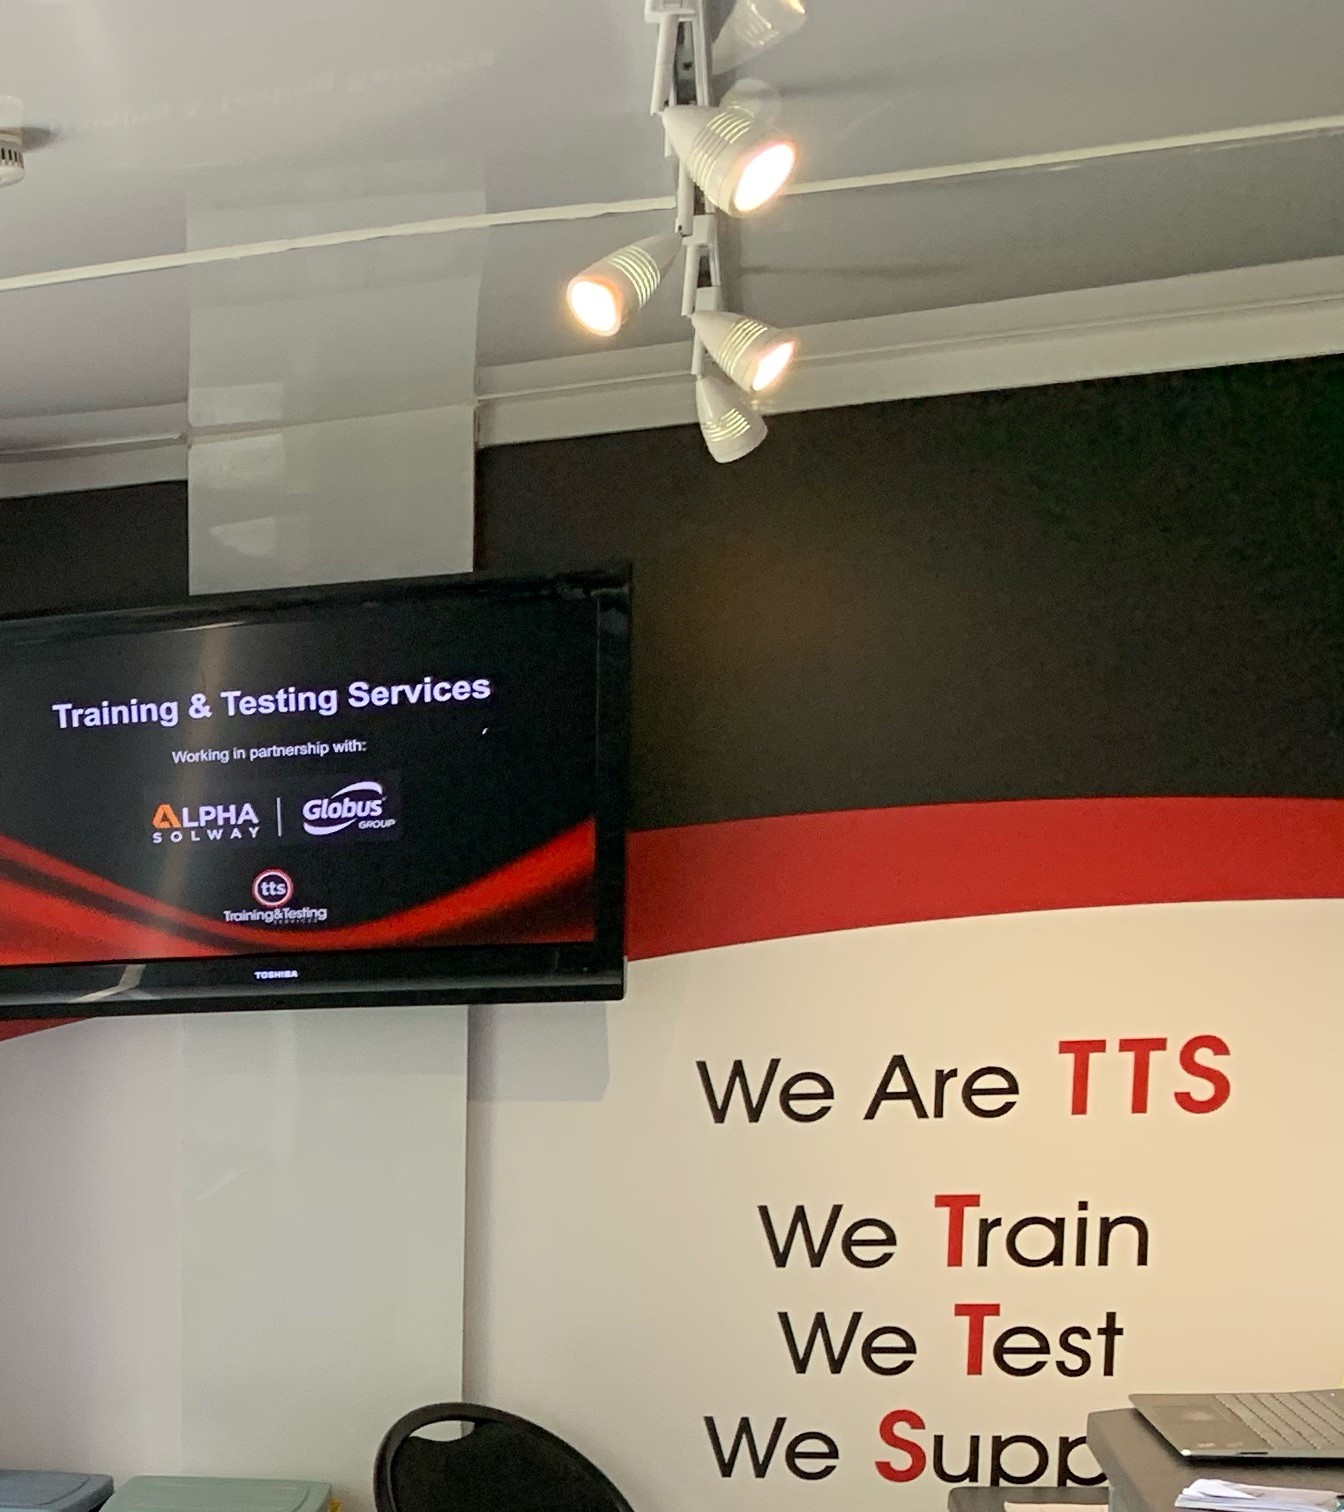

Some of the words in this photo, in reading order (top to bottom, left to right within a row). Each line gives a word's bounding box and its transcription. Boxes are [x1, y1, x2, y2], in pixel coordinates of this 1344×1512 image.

[52, 699, 178, 729] Training
[188, 693, 212, 719] &
[221, 687, 338, 716] Testing
[347, 676, 491, 708] Services
[171, 747, 229, 765] Working
[233, 746, 246, 760] in
[249, 740, 329, 761] partnership
[332, 738, 367, 754] with:
[151, 802, 260, 829] ALPHA
[302, 797, 383, 821] Globus
[152, 826, 261, 844] SOLWAY
[358, 818, 397, 830] GROUP
[260, 881, 286, 896] tts
[254, 970, 299, 980] TOSHIBA
[695, 1057, 835, 1124] We
[862, 1054, 1020, 1121] Are
[1058, 1034, 1232, 1115] TTS
[757, 1203, 898, 1269] We
[934, 1193, 1149, 1268] Train
[777, 1311, 917, 1376] We
[954, 1303, 1124, 1378] Test
[703, 1415, 840, 1481] We
